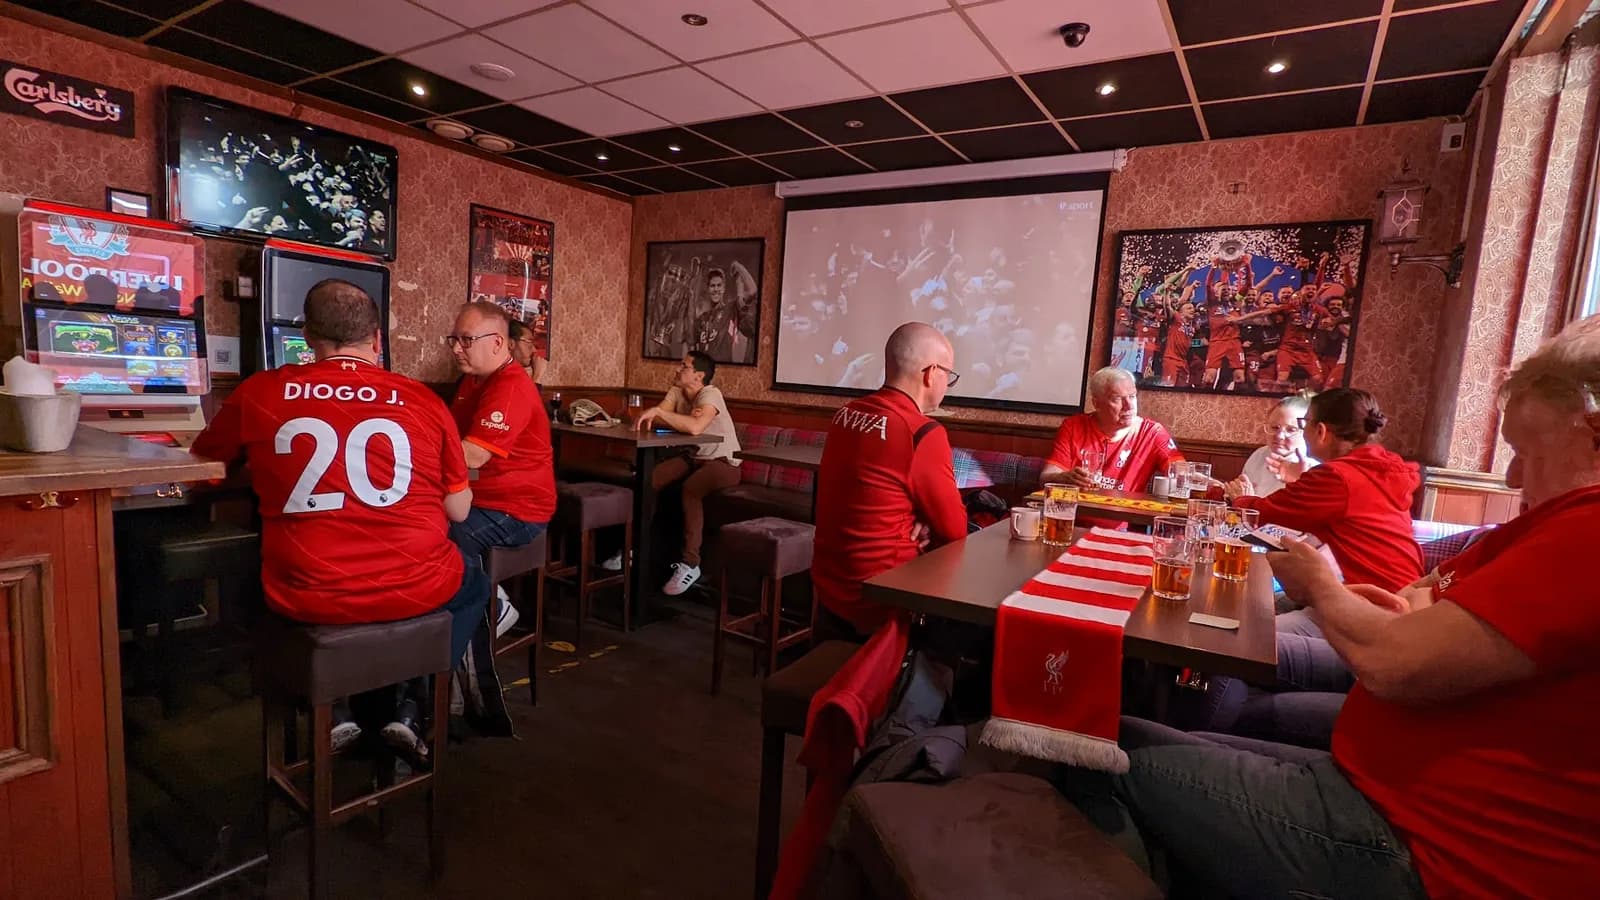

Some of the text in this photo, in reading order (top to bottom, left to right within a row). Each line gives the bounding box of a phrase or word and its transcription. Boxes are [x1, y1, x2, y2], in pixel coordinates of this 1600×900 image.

[4, 67, 121, 121] Carlsberg
[284, 382, 405, 406] DIOGO J.
[480, 418, 510, 432] Expedia
[832, 406, 888, 440] NWA
[274, 416, 413, 514] 20
